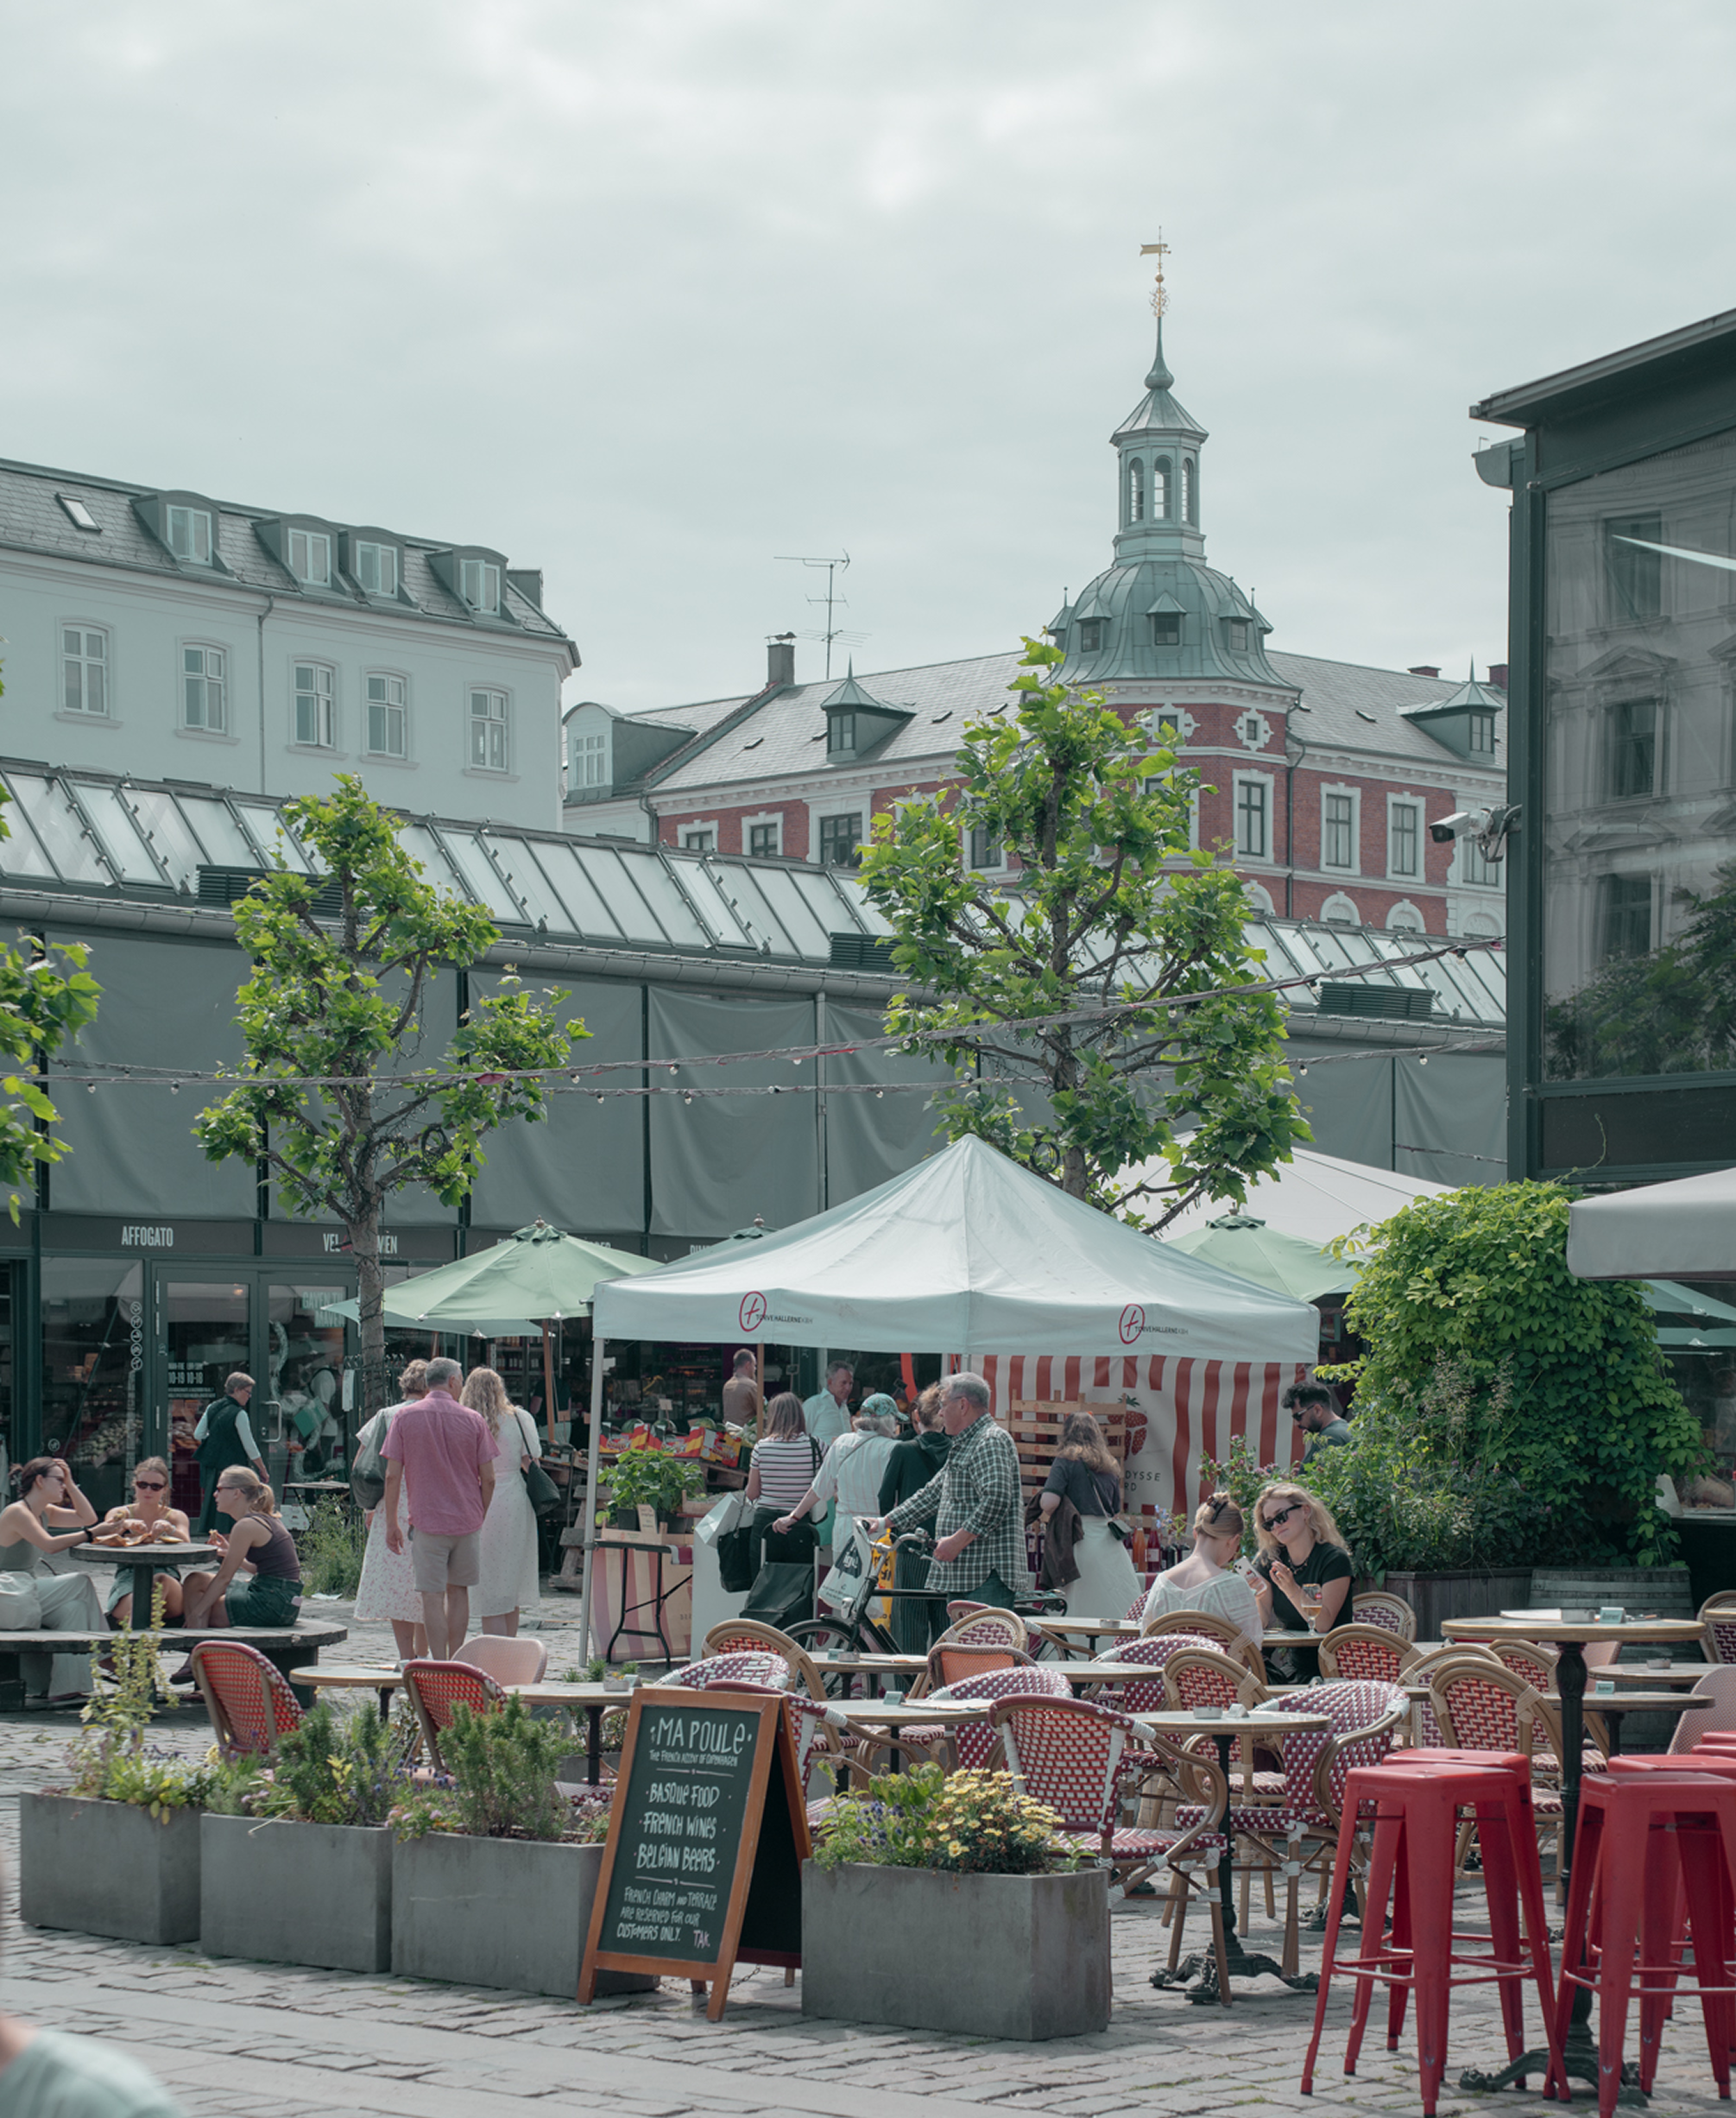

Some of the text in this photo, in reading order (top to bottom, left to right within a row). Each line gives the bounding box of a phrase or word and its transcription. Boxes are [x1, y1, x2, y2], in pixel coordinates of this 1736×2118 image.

[121, 1225, 174, 1247] AFFOGATO
[1124, 1470, 1161, 1482] DYSSE
[656, 1717, 685, 1747] MA
[691, 1785, 720, 1808] FOOD
